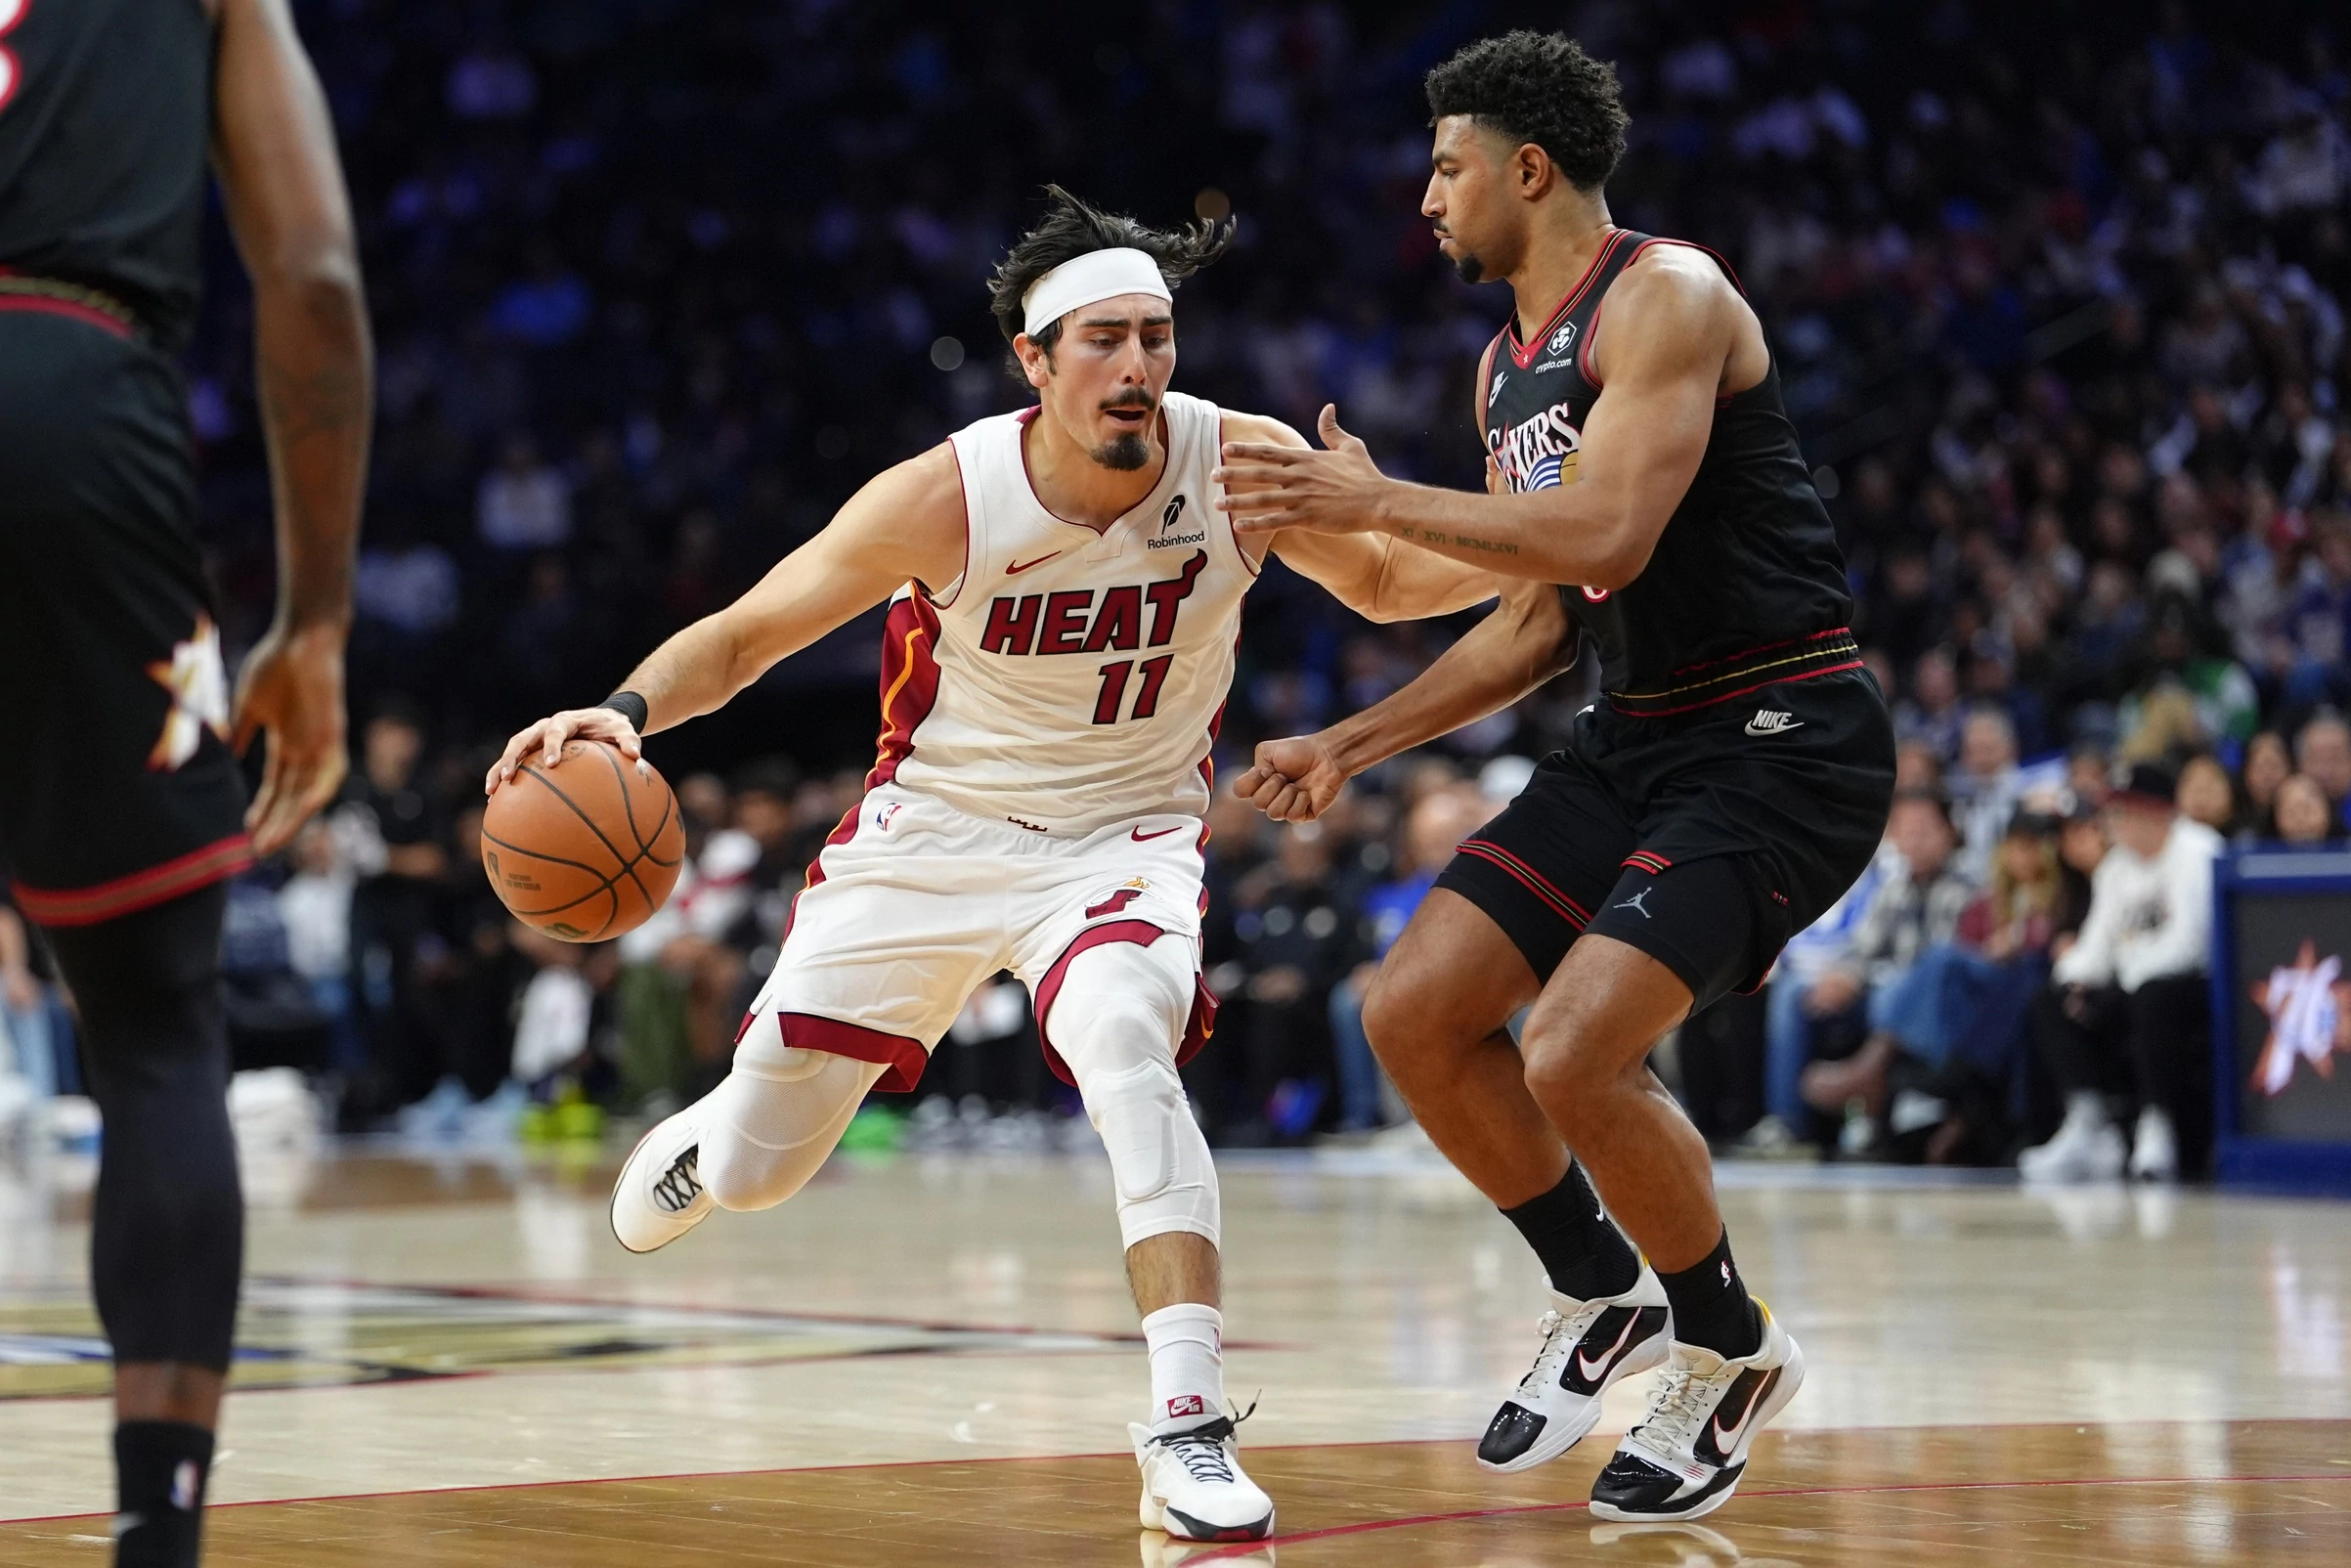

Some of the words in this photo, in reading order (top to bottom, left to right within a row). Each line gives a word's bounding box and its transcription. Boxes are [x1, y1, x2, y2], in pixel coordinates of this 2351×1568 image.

[1147, 531, 1205, 549] Robinhood
[980, 548, 1208, 656] HEAT
[1091, 654, 1174, 724] 11
[1752, 710, 1793, 729] NIKE
[1174, 1396, 1192, 1408] NIKE
[1188, 1404, 1200, 1413] AIR
